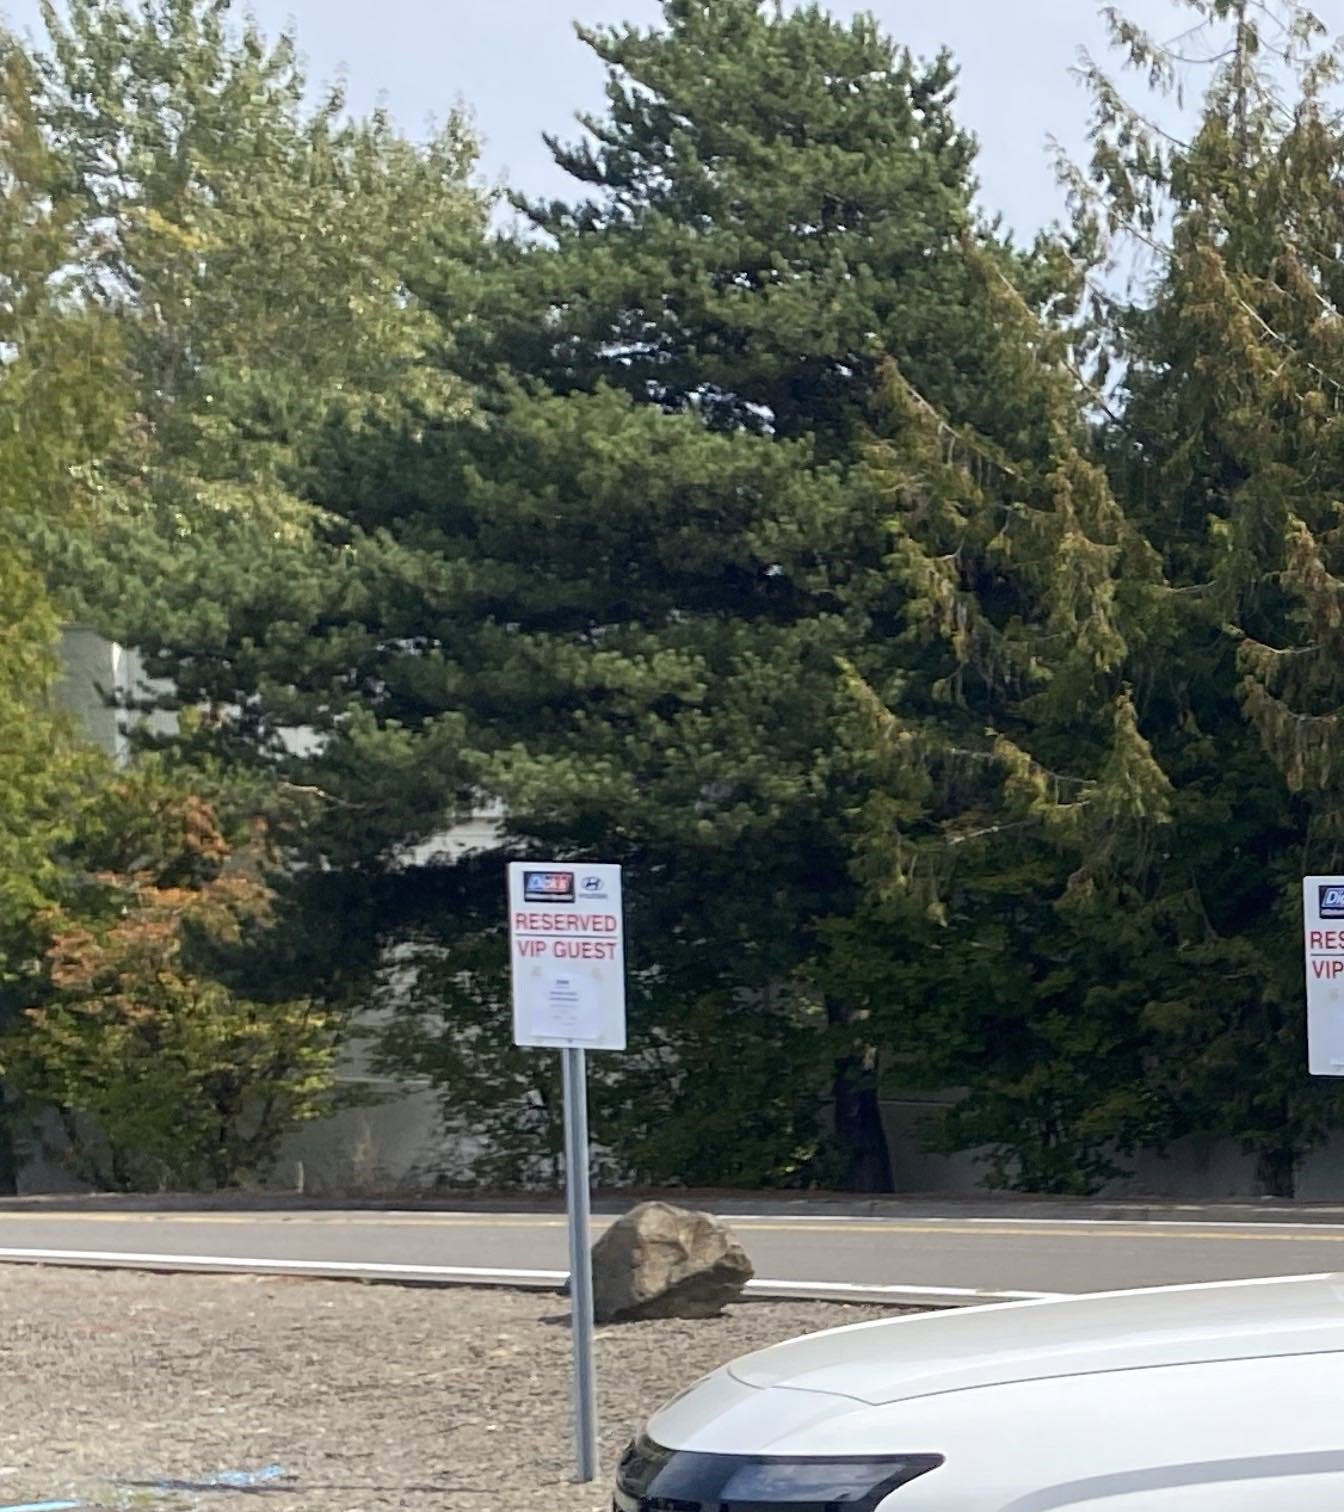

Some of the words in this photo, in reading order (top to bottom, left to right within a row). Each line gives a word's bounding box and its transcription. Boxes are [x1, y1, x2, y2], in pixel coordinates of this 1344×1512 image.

[515, 913, 617, 932] RESERVED
[517, 940, 547, 958] VIP
[553, 941, 617, 960] GUEST
[1312, 960, 1344, 979] VIP
